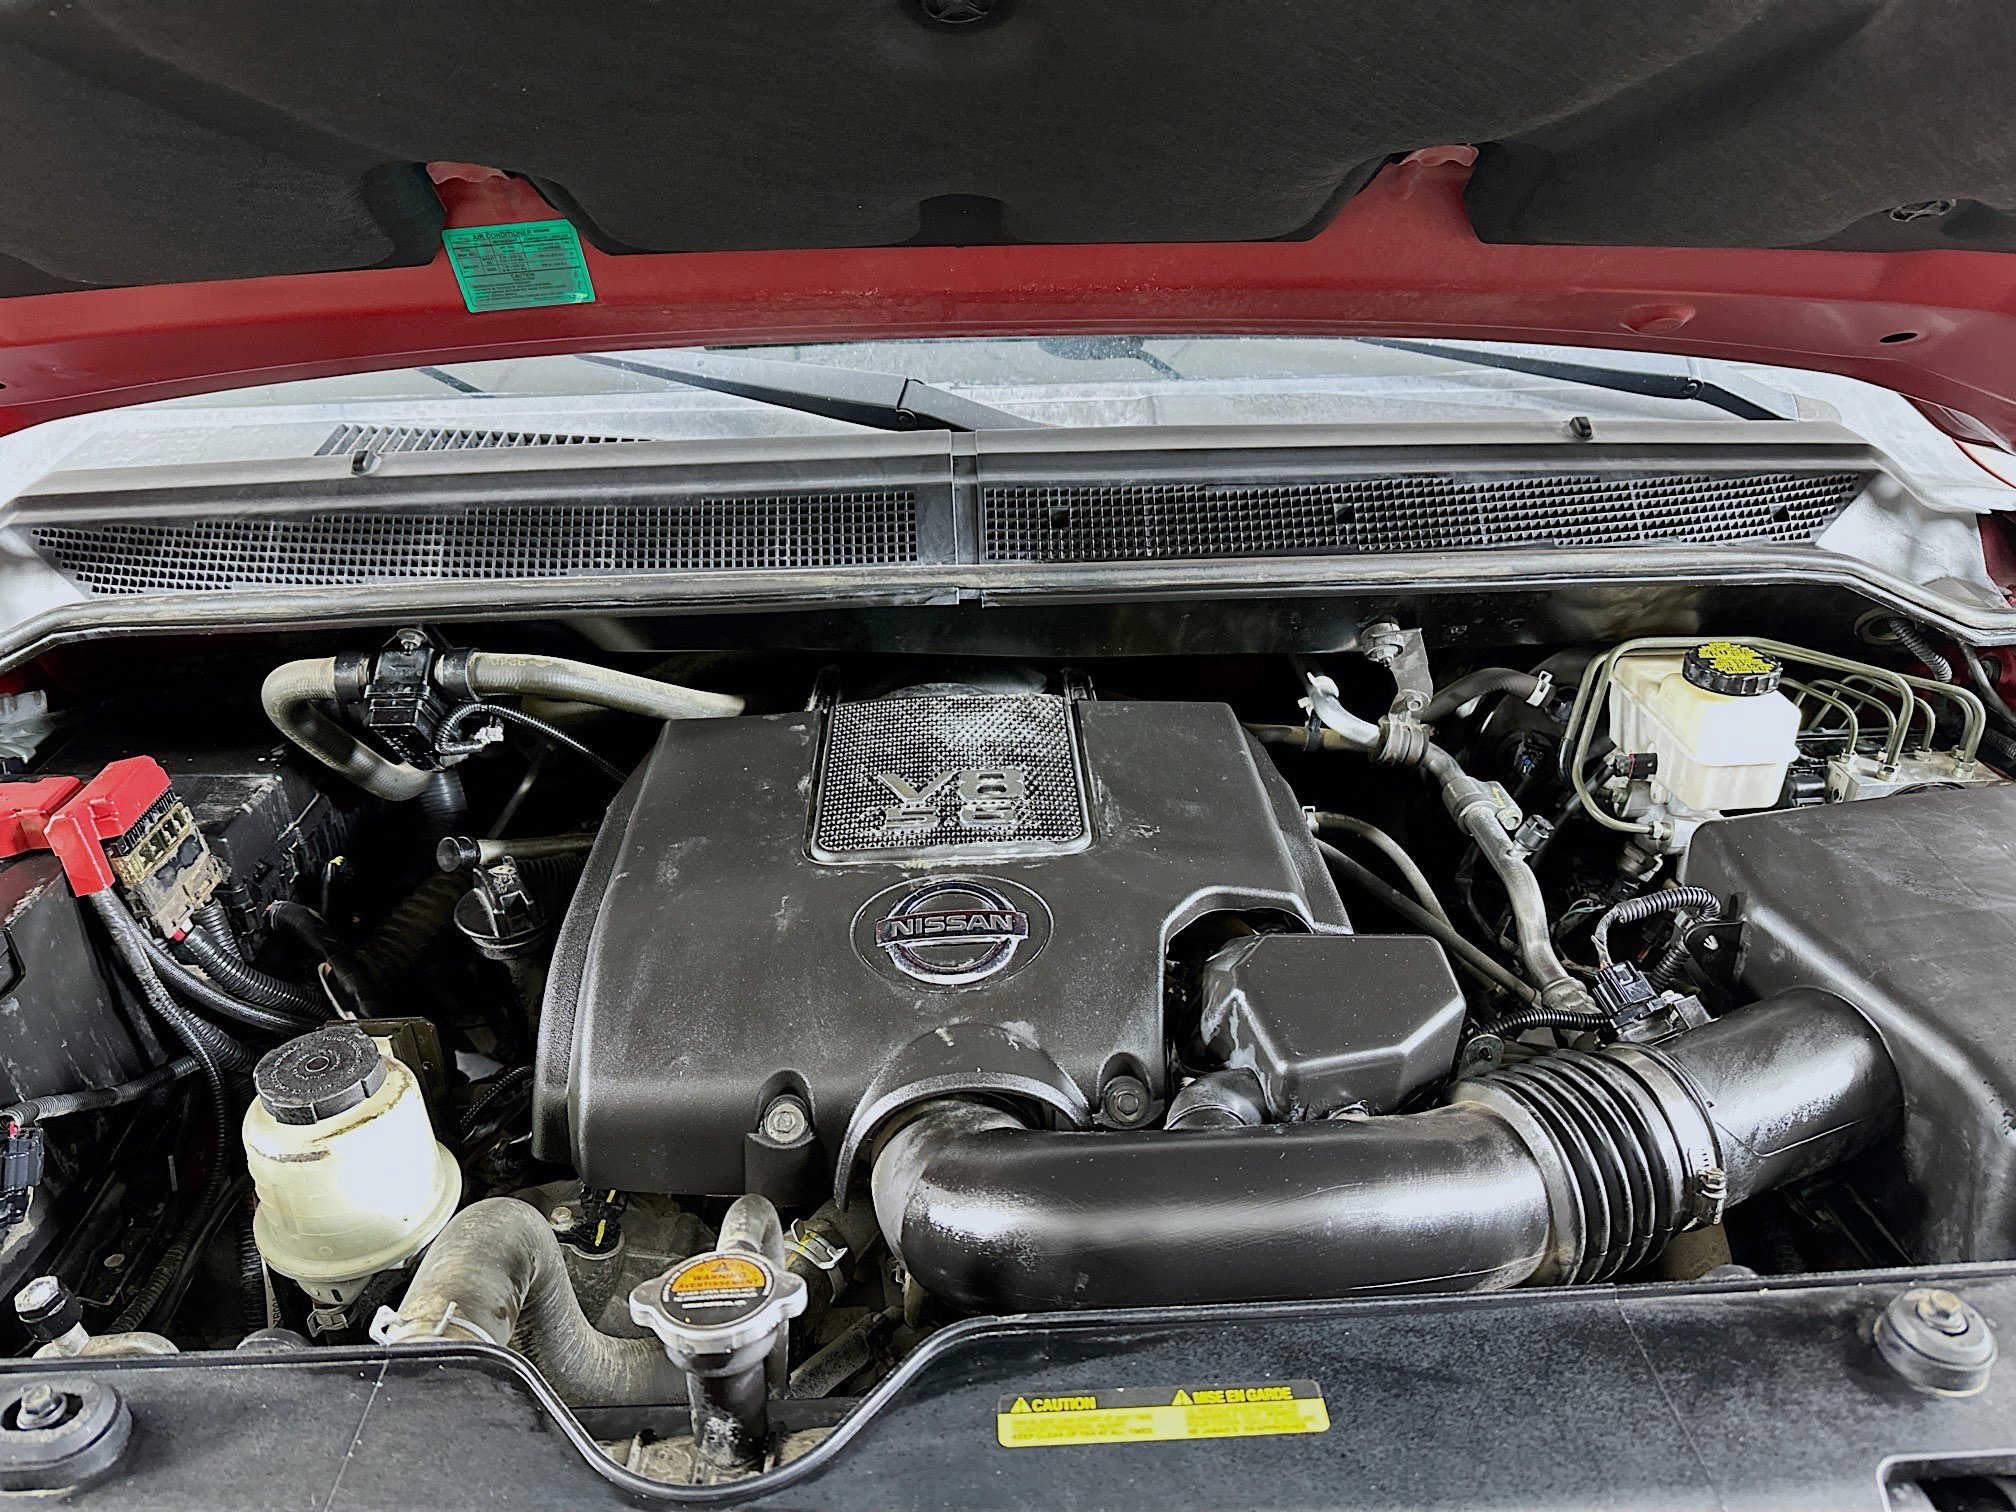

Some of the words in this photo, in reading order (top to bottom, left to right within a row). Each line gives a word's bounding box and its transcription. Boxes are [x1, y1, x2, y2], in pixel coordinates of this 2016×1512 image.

[876, 767, 1025, 804] V8
[890, 914, 1014, 938] NISSAN
[1031, 1396, 1097, 1412] CAUTION
[1192, 1390, 1226, 1404] MISE
[1225, 1388, 1246, 1403] EN
[1245, 1386, 1293, 1402] GARDE
